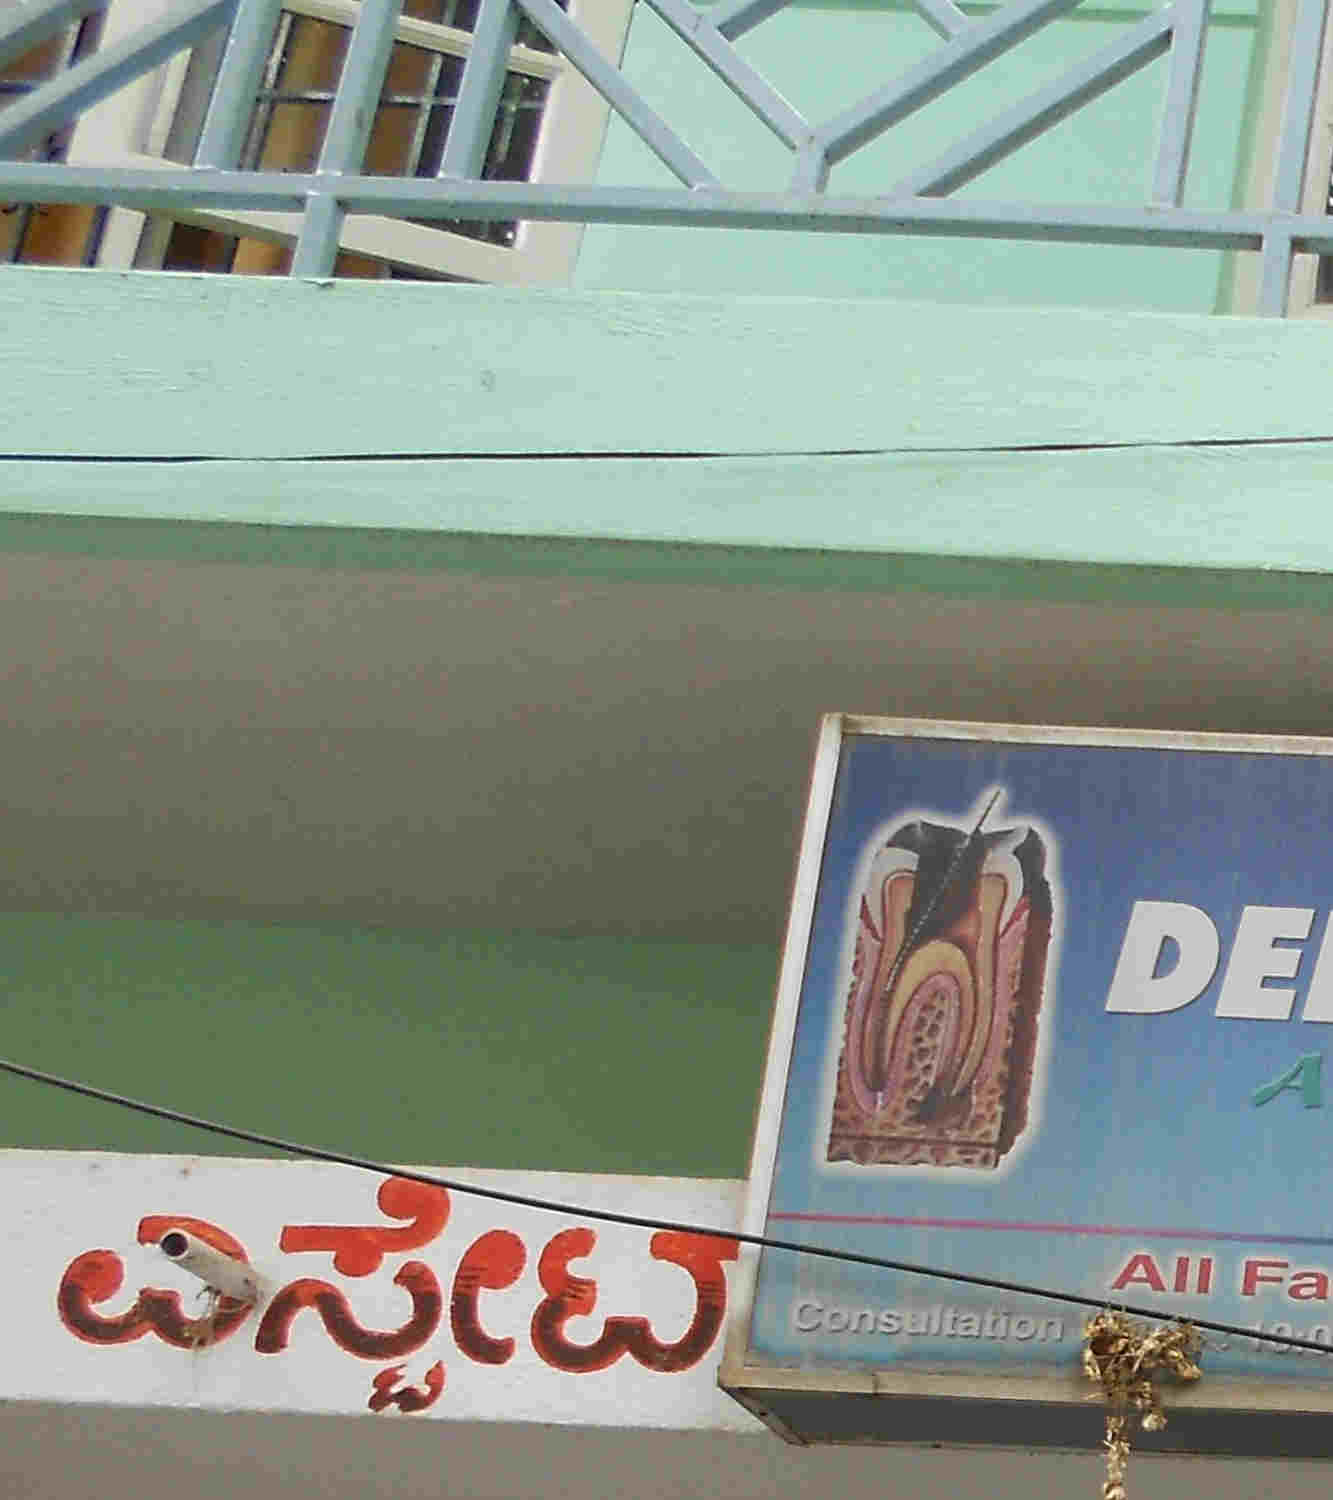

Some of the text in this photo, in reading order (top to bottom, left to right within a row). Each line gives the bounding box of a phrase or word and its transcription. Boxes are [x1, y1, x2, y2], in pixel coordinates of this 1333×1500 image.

[1250, 1051, 1323, 1110] A
[1111, 1253, 1212, 1294] All
[792, 1299, 1064, 1343] Consultation
